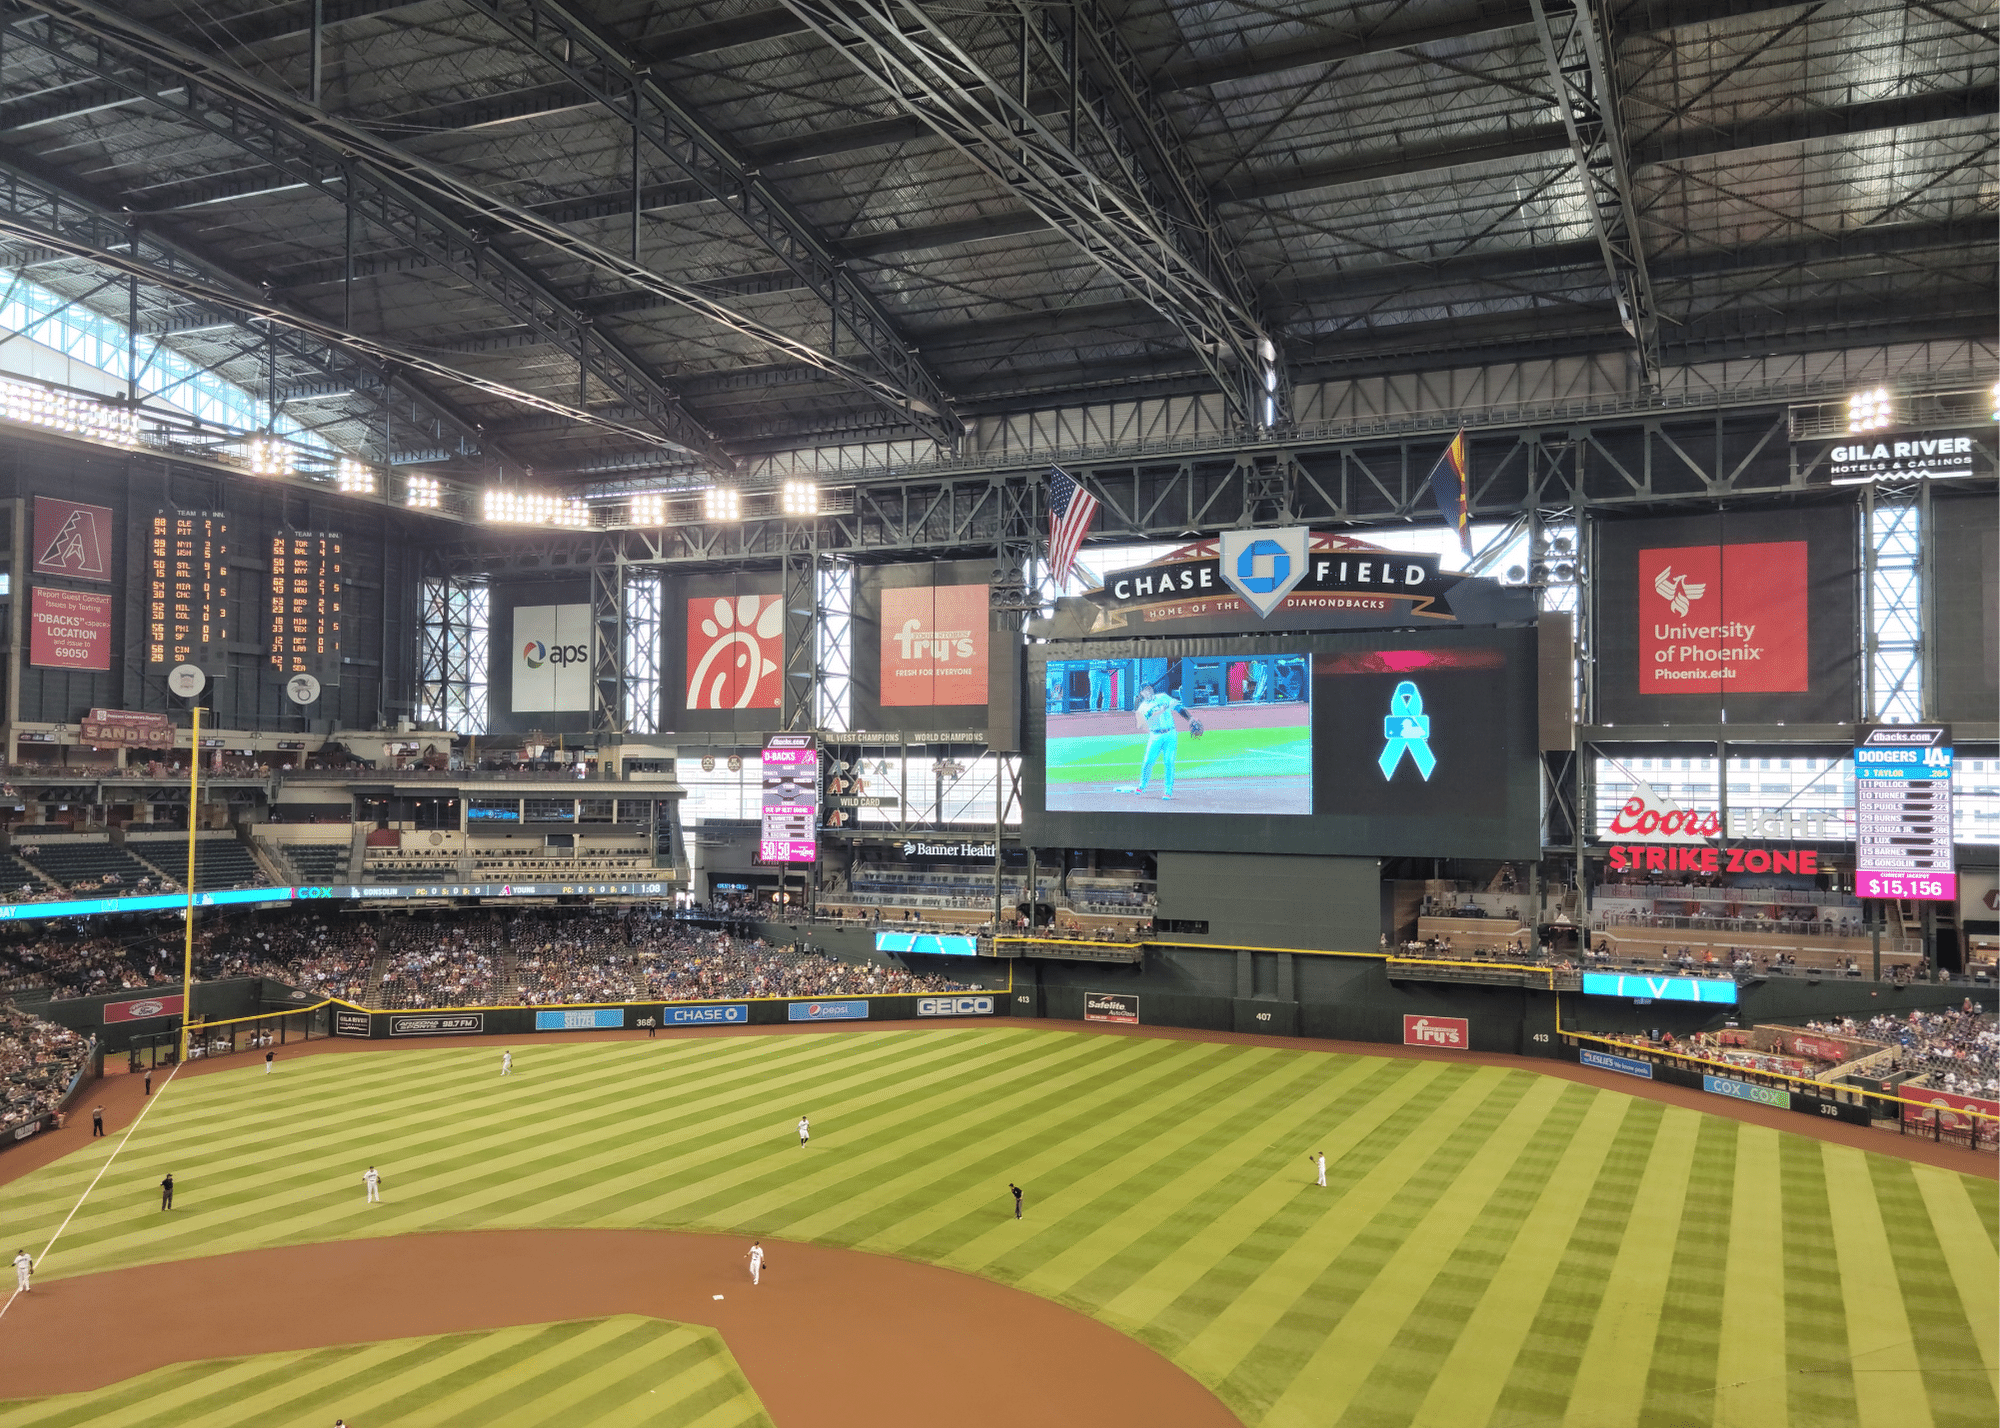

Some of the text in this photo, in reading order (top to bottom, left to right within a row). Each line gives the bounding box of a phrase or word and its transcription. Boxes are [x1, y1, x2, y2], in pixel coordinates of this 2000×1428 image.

[1831, 438, 1972, 462] GILA RIVER
[1831, 463, 1885, 473] HOTELS
[1908, 457, 1972, 468] CASINOS
[154, 527, 166, 535] 34
[154, 539, 166, 548] 99
[154, 560, 165, 569] 50
[156, 570, 165, 578] 15
[153, 581, 165, 590] 54
[1114, 562, 1425, 599] CHASE FIELD
[38, 590, 109, 604] Report Guest Conduct
[79, 603, 101, 613] Texting
[152, 602, 164, 611] 52
[1150, 599, 1385, 618] HOME OF THE DIAMONDBACKS
[34, 613, 84, 626] "DBACKS"
[48, 626, 96, 640] LOCATION
[1655, 621, 1755, 642] University
[893, 619, 973, 662] fry's
[56, 647, 88, 659] 69050
[550, 644, 587, 668] aps
[1655, 644, 1760, 662] of Phoenix
[1655, 667, 1736, 679] Phoenix.edu
[826, 734, 899, 742] NL WEST CHAMPIONS
[1873, 733, 1932, 742] dbacks.com
[765, 752, 796, 761] D-BACKS
[1859, 751, 1917, 763] DODGERS
[1923, 748, 1950, 767] LA
[840, 798, 880, 806] WILD CARD
[1609, 797, 1831, 838] Coors LIGHT
[762, 842, 774, 856] 50
[778, 842, 790, 856] 50
[917, 843, 996, 857] Banner Health
[1609, 845, 1818, 874] STRIKE ZONE
[298, 886, 333, 899] COX
[641, 884, 660, 893] 1:08
[1869, 879, 1942, 897] $15,156
[1017, 995, 1030, 1004] 413
[1088, 1001, 1125, 1010] Safelite
[822, 1006, 848, 1016] pepsi
[920, 998, 992, 1014] GEICO
[674, 1009, 722, 1021] CHASE
[1256, 1012, 1272, 1021] 407
[565, 1016, 595, 1027] SELTZER
[637, 1018, 651, 1027] 368
[1412, 1019, 1460, 1043] fry's
[1533, 1033, 1549, 1042] 413
[1590, 1055, 1614, 1067] LESLIE'S
[1714, 1080, 1779, 1103] COX COX
[1820, 1104, 1838, 1116] 376
